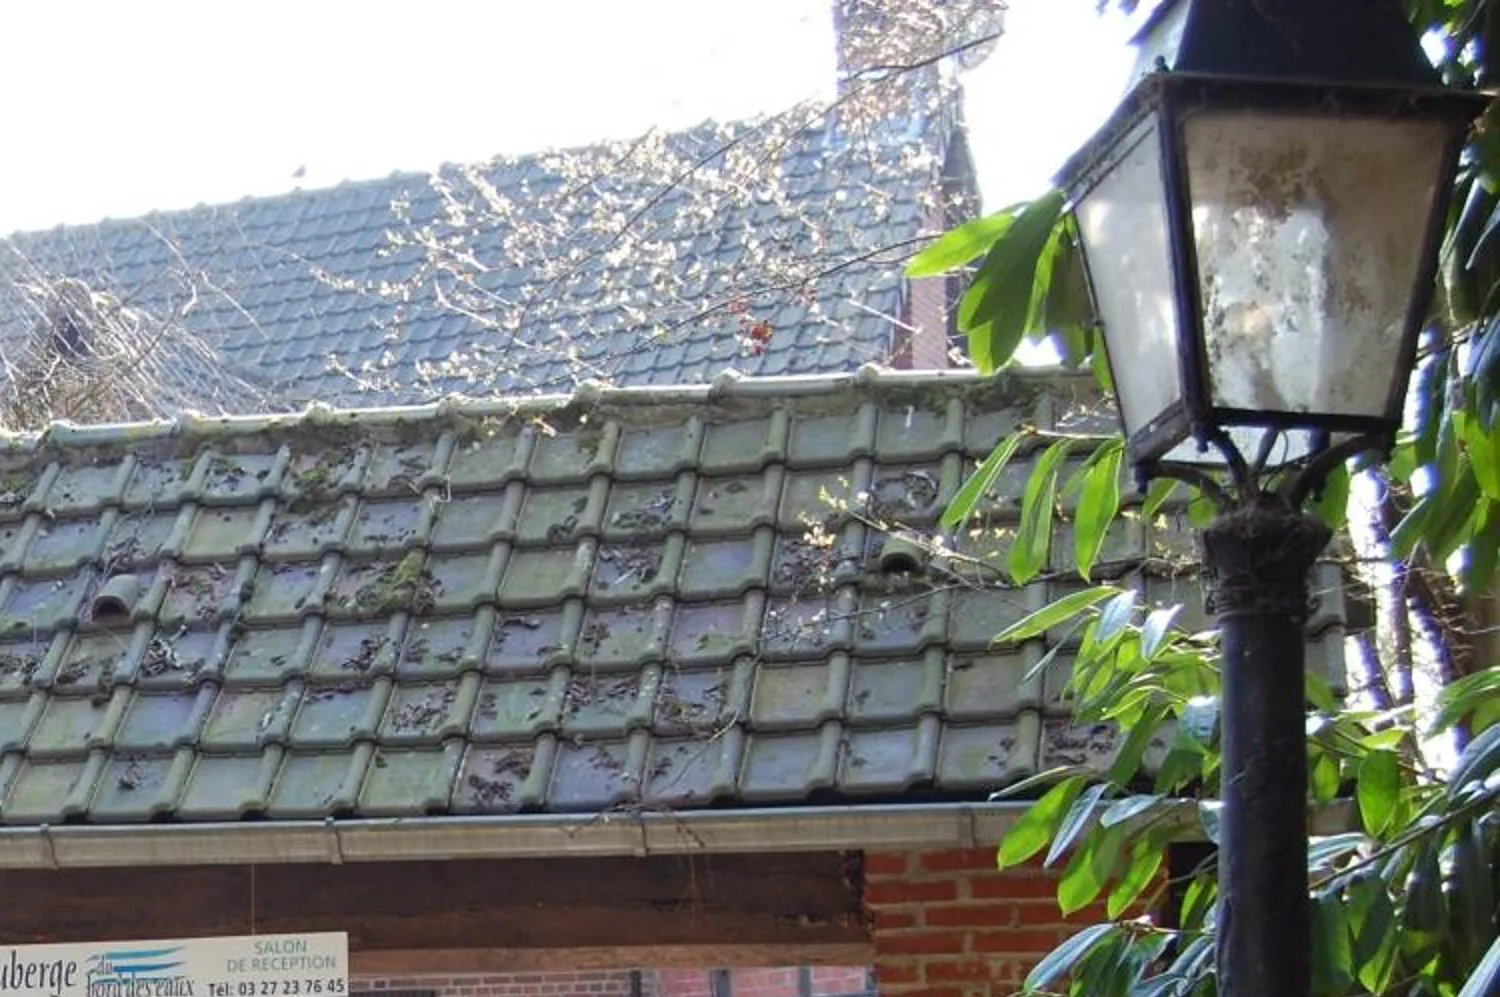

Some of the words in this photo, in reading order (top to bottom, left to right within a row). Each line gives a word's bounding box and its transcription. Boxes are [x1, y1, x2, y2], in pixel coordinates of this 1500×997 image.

[253, 939, 307, 955] SALON
[227, 958, 246, 973] DE
[239, 981, 257, 996] 03
[260, 980, 278, 995] 27
[283, 979, 300, 995] 23
[306, 979, 323, 993] 76
[326, 978, 345, 992] 45
